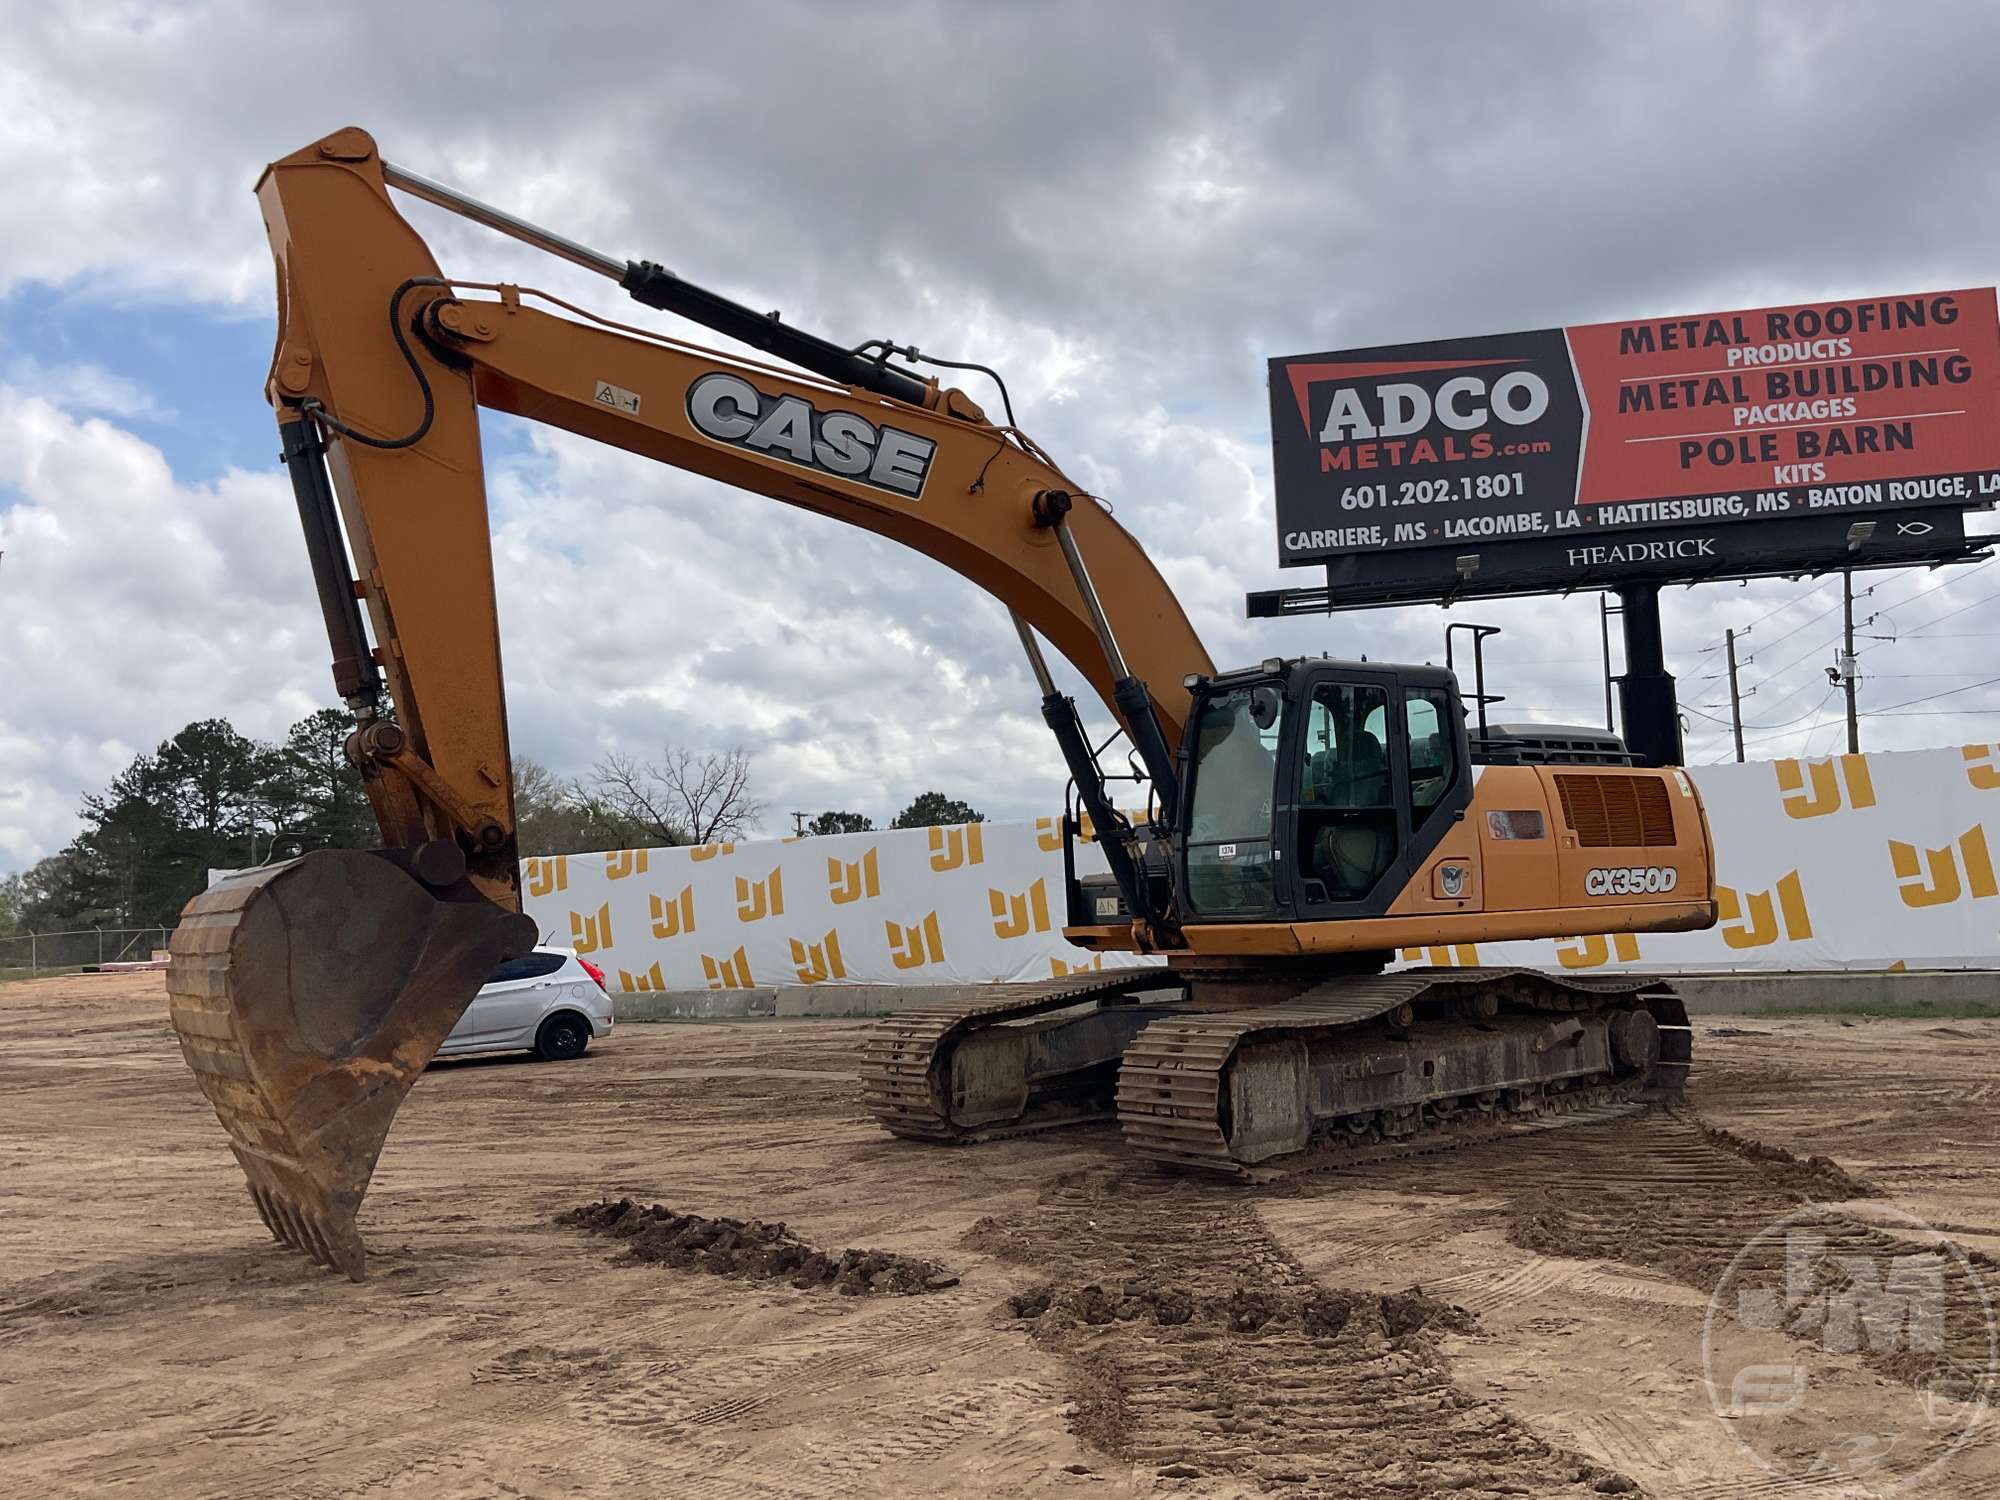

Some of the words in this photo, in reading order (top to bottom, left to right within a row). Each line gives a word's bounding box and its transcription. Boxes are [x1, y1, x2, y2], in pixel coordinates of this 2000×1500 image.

[1619, 317, 1750, 355] METAL
[1766, 296, 1959, 341] ROOFING
[1727, 337, 1852, 367] PRODUCTS
[1618, 376, 1750, 413] METAL
[1766, 354, 1973, 401] BUILDING
[1319, 371, 1549, 443] ADCO
[1733, 397, 1857, 426] PACKAGES
[690, 374, 932, 496] CASE
[1679, 434, 1780, 469] POLE
[1797, 422, 1914, 459] BARN
[1340, 472, 1524, 510] 601.202.1801
[1774, 462, 1826, 485] KITS
[1284, 526, 1388, 551] CARRIERE,
[1394, 521, 1427, 543] MS
[1444, 511, 1549, 538] LACOMBE,
[1555, 508, 1581, 530] LA
[1598, 495, 1750, 526] HATTIESBURG,
[1756, 491, 1790, 512] MS
[1808, 482, 1882, 508] BATON
[1889, 477, 1973, 500] ROUGE,
[1978, 473, 2000, 494] LA
[1567, 537, 1717, 567] HEADRICK
[1585, 867, 1677, 896] CX350D
